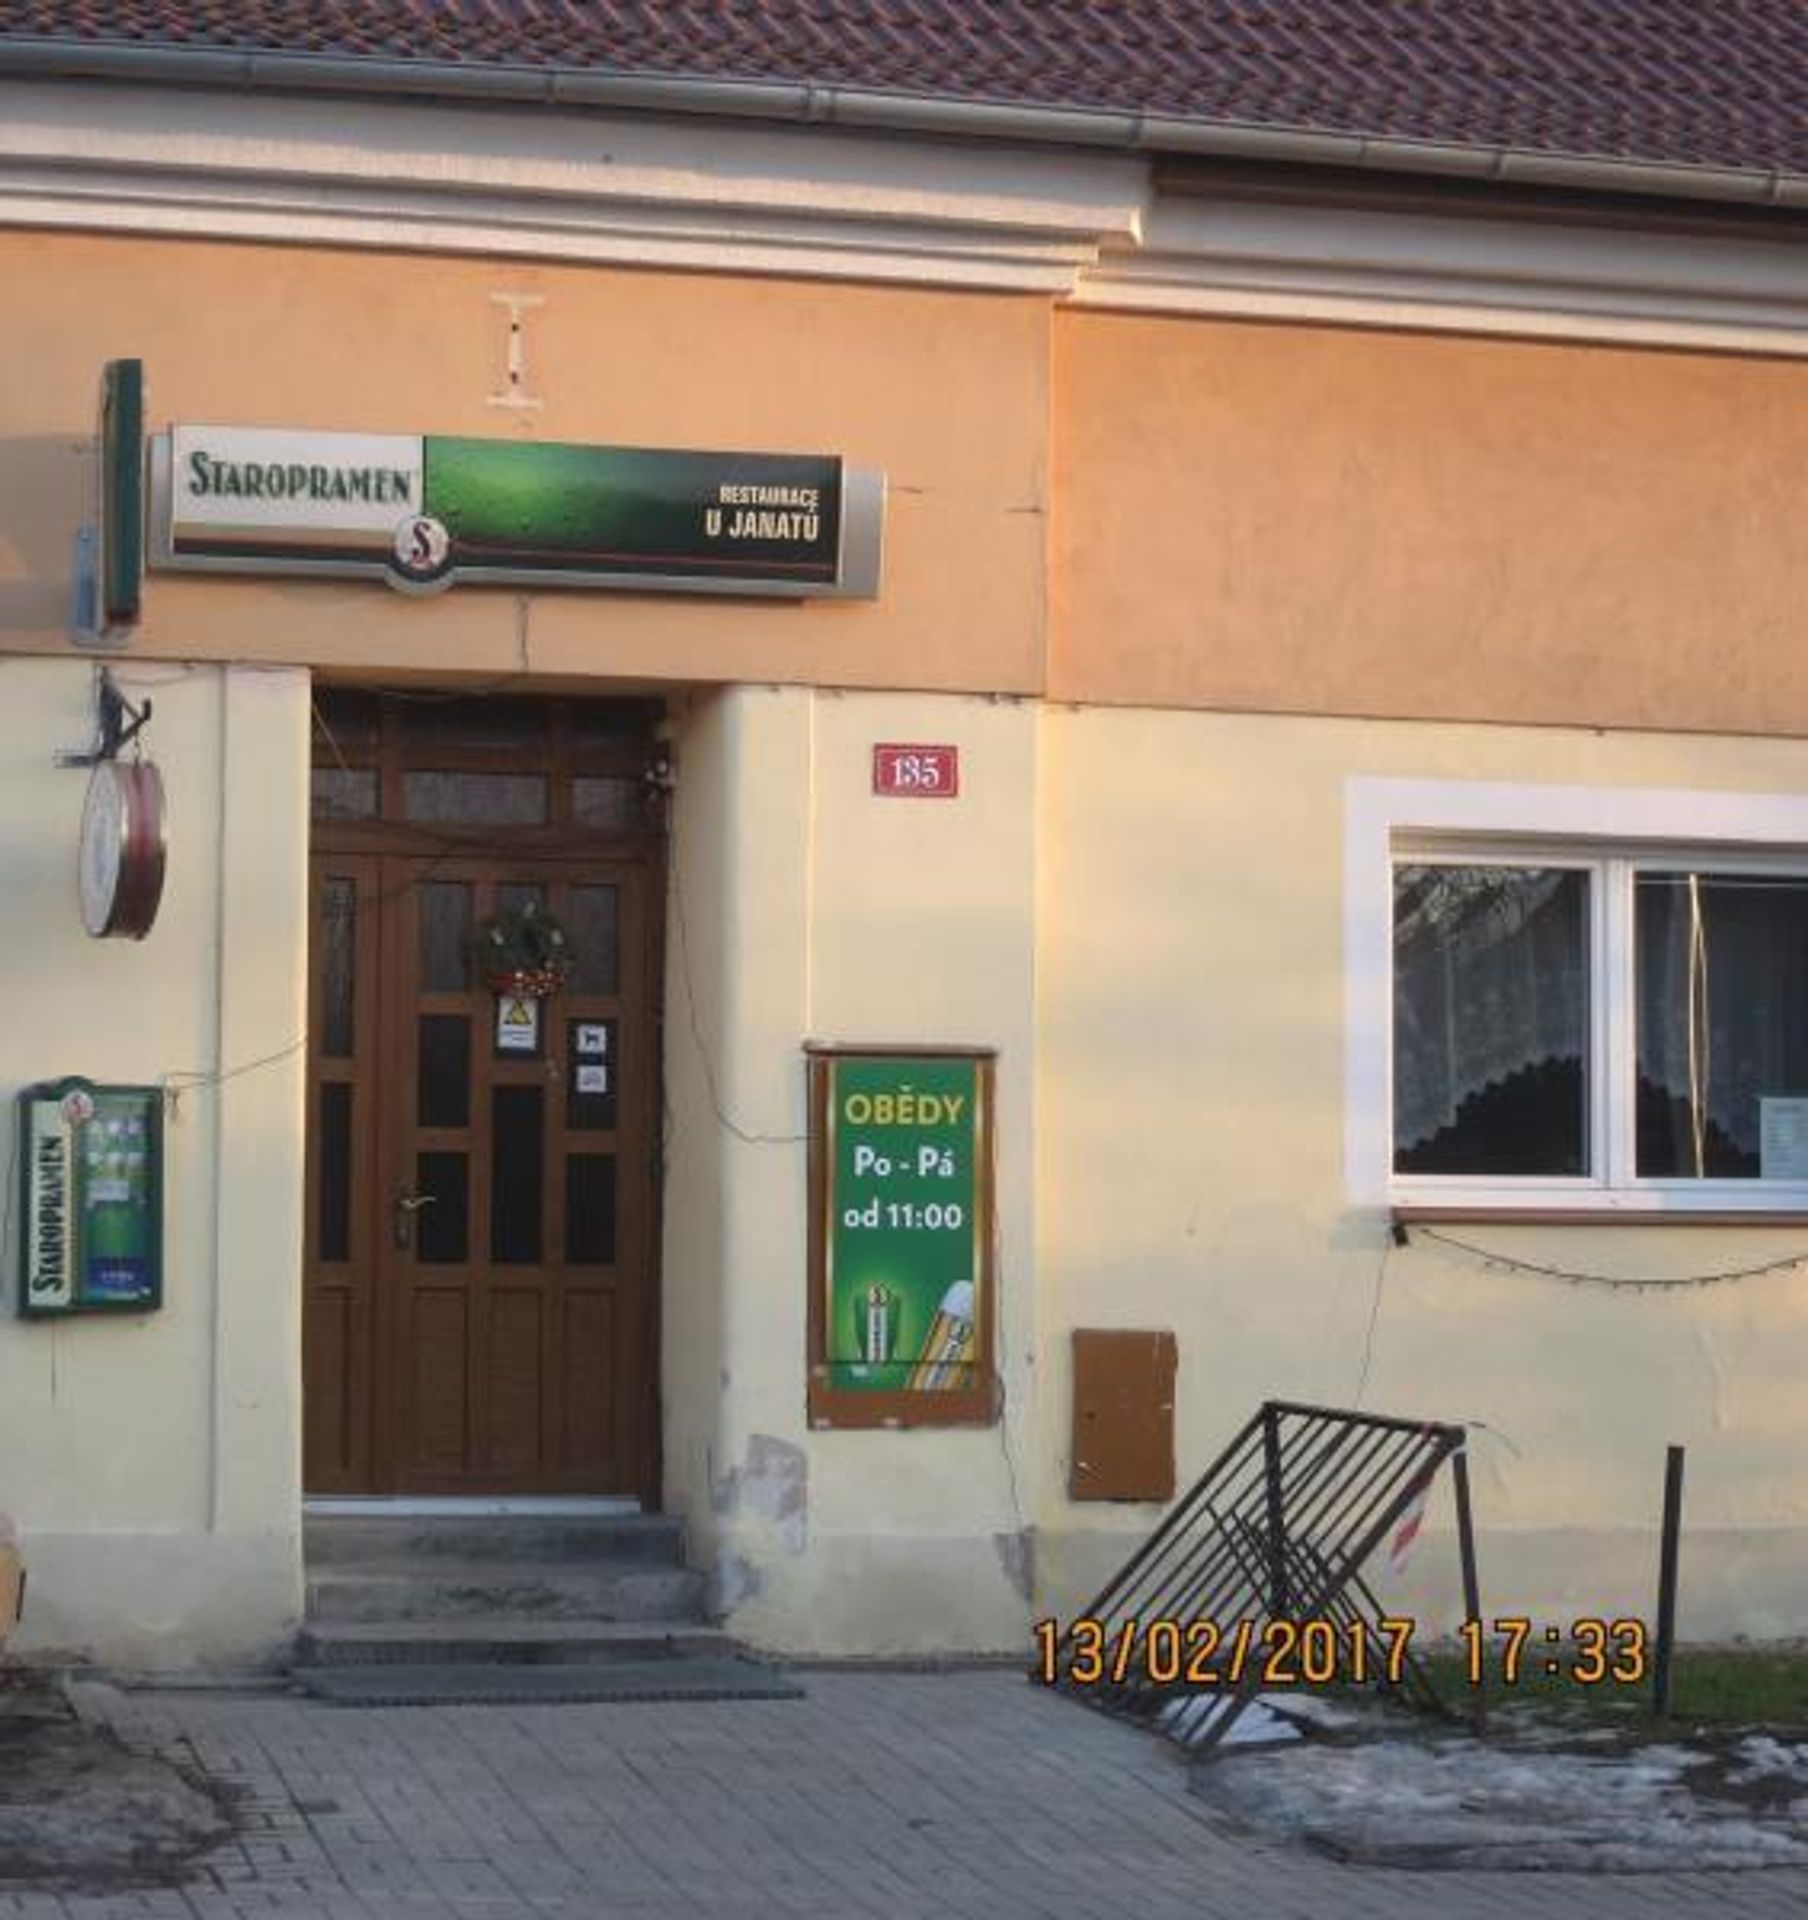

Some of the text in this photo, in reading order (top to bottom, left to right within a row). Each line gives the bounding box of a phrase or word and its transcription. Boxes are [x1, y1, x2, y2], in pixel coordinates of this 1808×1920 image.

[189, 451, 412, 502] STAROPRAMEN
[719, 485, 820, 508] RESTAURACE
[706, 508, 721, 537] U
[411, 520, 431, 567] S
[890, 755, 940, 788] 135
[844, 1084, 965, 1126] OBĚDY
[853, 1146, 892, 1177] Po
[918, 1146, 954, 1177] Pá
[32, 1135, 65, 1292] STAROPRAMEN
[844, 1198, 963, 1230] od 11:00
